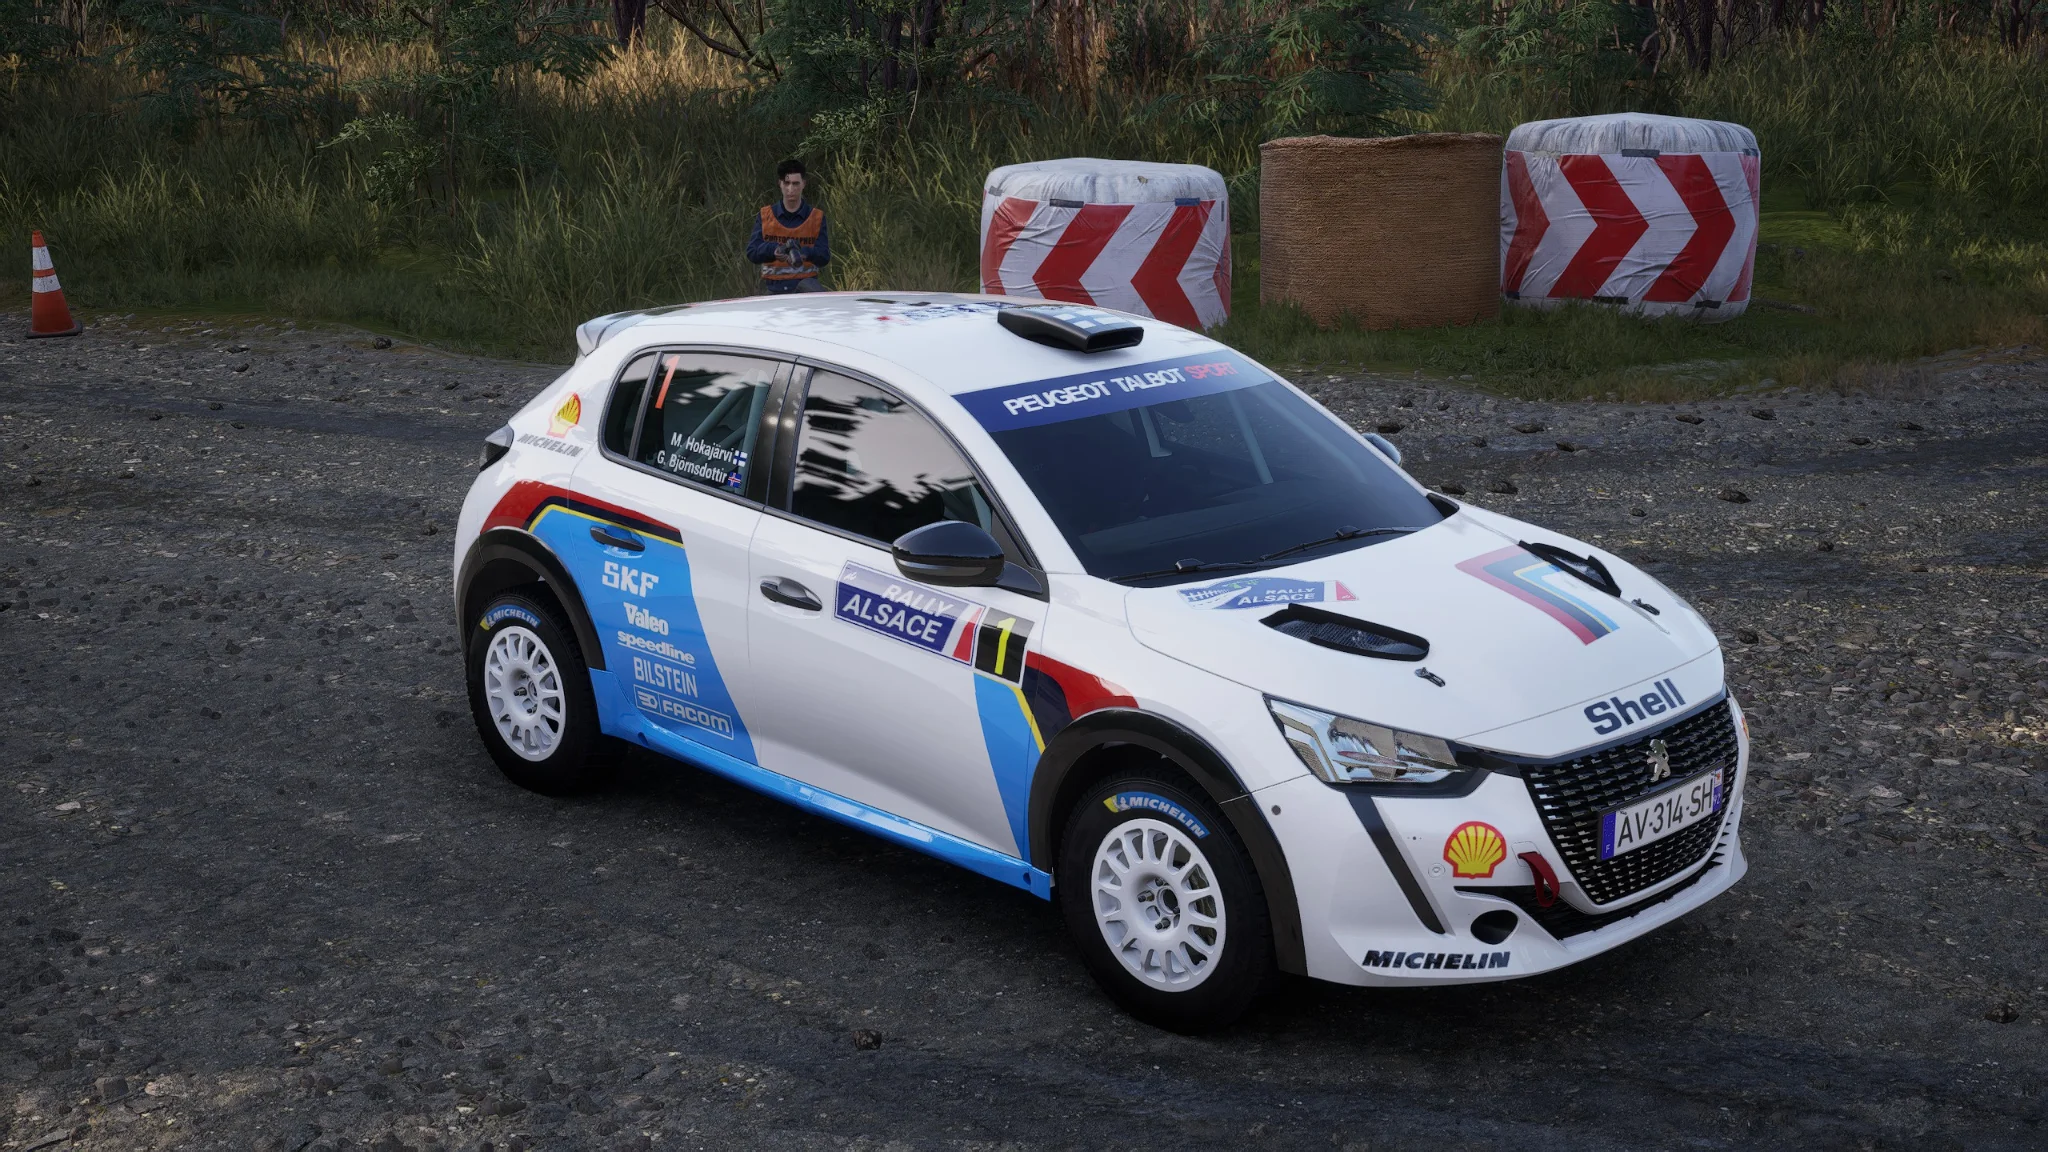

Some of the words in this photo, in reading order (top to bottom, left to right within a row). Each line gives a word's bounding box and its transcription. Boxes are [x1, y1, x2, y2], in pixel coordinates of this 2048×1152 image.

[655, 355, 681, 409] 1
[1002, 380, 1111, 416] PEUGEOT
[1110, 368, 1187, 393] TALBOT
[1183, 362, 1239, 380] SPORT
[517, 432, 584, 458] MICHELIN
[670, 431, 683, 448] M.
[685, 436, 734, 463] Hokajärvi
[656, 450, 666, 466] G.
[668, 453, 728, 484] Björnsdottir
[601, 560, 660, 598] SKF
[1265, 587, 1315, 595] RALLY
[880, 583, 954, 618] RALLY
[1238, 593, 1315, 605] ALSACE
[493, 608, 539, 628] MICHELIN
[623, 602, 670, 637] Valeo
[842, 594, 943, 643] ALSACE
[617, 630, 697, 665] speedline
[994, 616, 1017, 676] 1
[633, 656, 699, 699] BILSTEIN
[663, 699, 730, 734] FACOM
[1583, 677, 1687, 736] Shell
[1129, 796, 1206, 838] MICHELIN
[1362, 949, 1511, 970] MICHELIN
